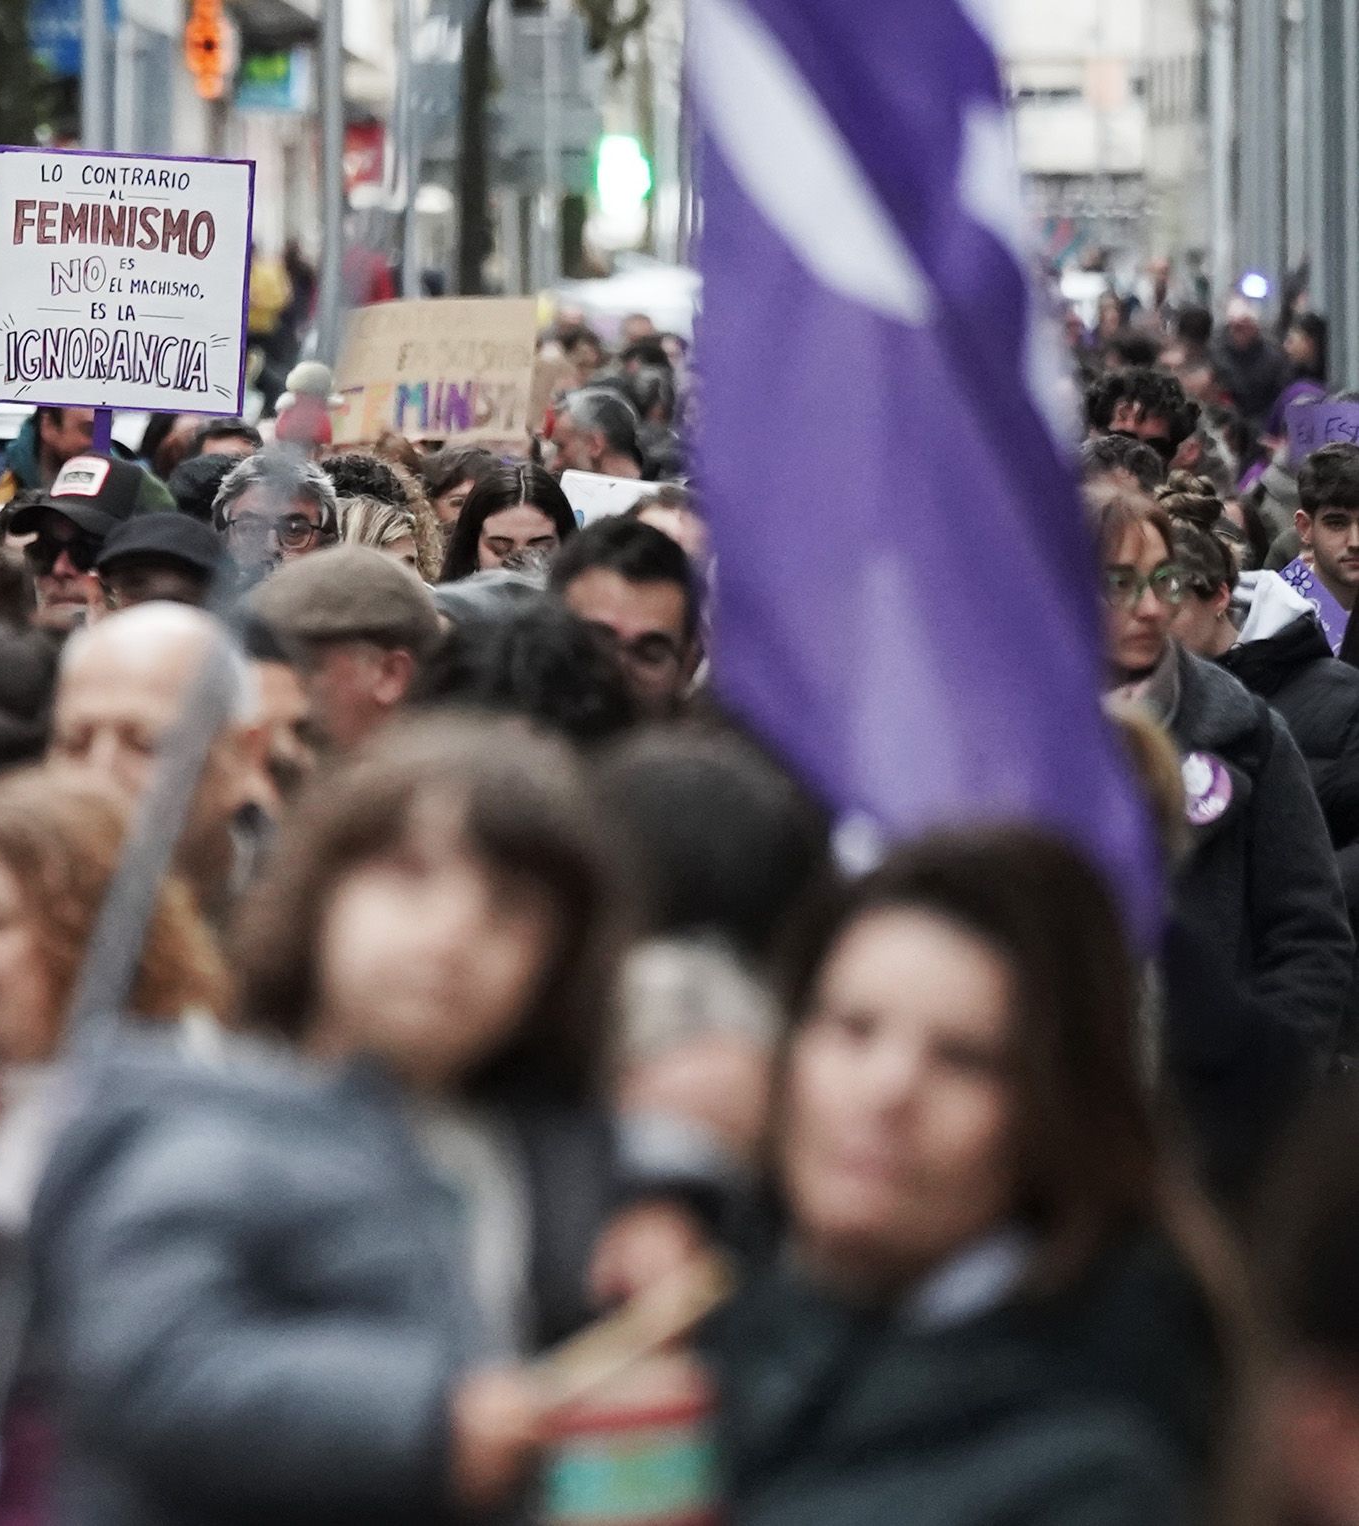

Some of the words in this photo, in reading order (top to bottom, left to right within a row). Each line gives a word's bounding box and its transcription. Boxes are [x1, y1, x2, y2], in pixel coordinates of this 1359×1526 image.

[41, 164, 63, 183] LO
[81, 165, 190, 190] CONTRARIO
[109, 190, 125, 200] AL
[13, 200, 216, 260] FEMINISMO
[51, 256, 107, 296] NO
[120, 258, 135, 270] ES
[109, 278, 123, 293] EL
[130, 280, 205, 300] MACHISMO,
[91, 303, 106, 319] ES
[118, 305, 136, 321] LA
[4, 327, 208, 393] IGNORANCIA
